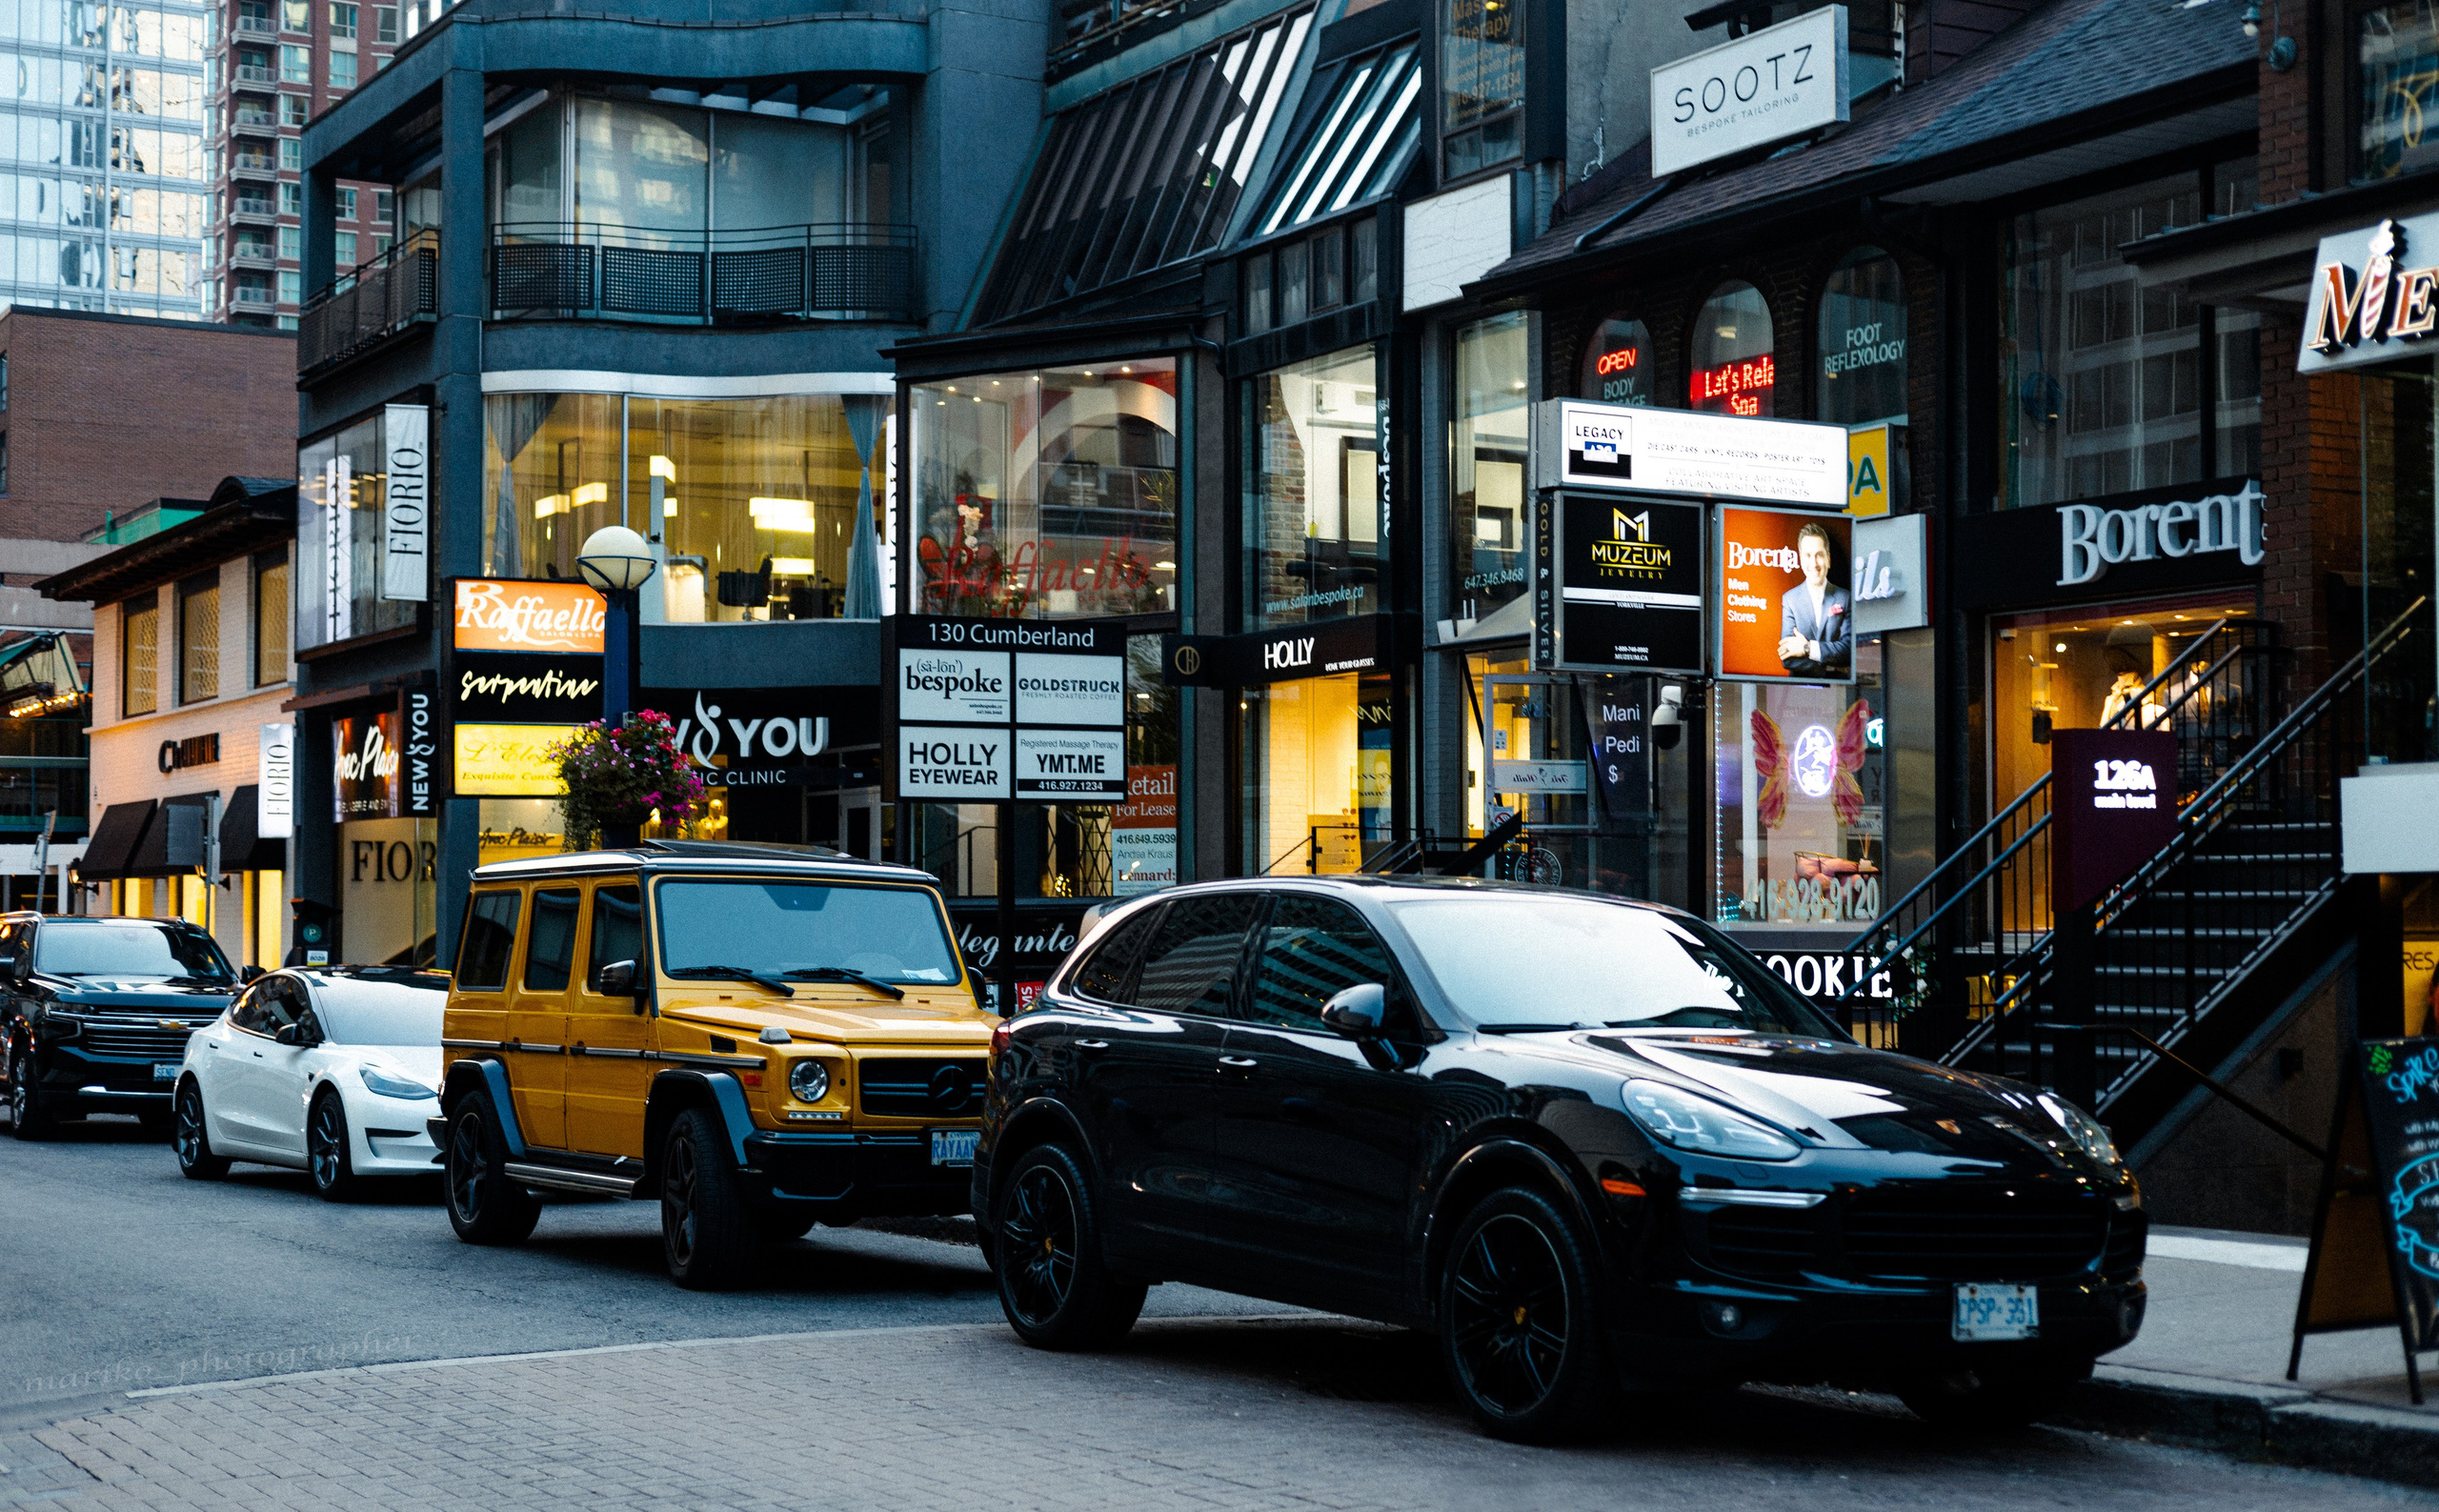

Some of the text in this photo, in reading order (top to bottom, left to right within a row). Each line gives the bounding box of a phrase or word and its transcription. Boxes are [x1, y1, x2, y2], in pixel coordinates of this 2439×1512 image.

[1453, 12, 1512, 48] Therapy
[1674, 44, 1813, 123] SOOTZ
[1687, 93, 1799, 137] BESPOKE TAILORING
[1846, 323, 1882, 346] FOOT
[1598, 348, 1637, 374] OPEN
[1824, 338, 1905, 375] REFLEXOLOGY
[1604, 377, 1635, 399] BODY
[1704, 364, 1739, 397] Let's
[1576, 425, 1623, 440] LEGACY
[1726, 449, 1759, 459] RECORDS
[390, 448, 424, 556] FIORIO
[1769, 486, 1810, 497] ARTISTS
[1540, 502, 1549, 556] GOLD
[2056, 478, 2268, 586] Borent
[1591, 543, 1671, 567] MUZEUM
[1464, 567, 1524, 590] 647.346.8468
[1600, 568, 1663, 580] JEWELRY
[1727, 577, 1749, 591] Men
[1265, 584, 1364, 615] www.salonbespoke.ca
[1727, 594, 1767, 610] Clothing
[456, 595, 606, 642] Raffaello
[1540, 590, 1549, 659] SILVER
[1727, 609, 1757, 623] Stores
[929, 623, 1095, 648] 130 Cumberland
[1264, 637, 1315, 670] HOLLY
[906, 666, 1002, 699] bespoke
[1018, 678, 1120, 694] GOLDSTRUCK
[1602, 704, 1640, 722] Mani
[727, 716, 829, 757] YOU
[1020, 738, 1119, 751] Registered Massage Therapy
[1605, 736, 1640, 754] Pedi
[412, 694, 429, 811] NEW YOU
[909, 742, 998, 766] HOLLY
[1037, 754, 1105, 774] YMT.ME
[267, 744, 290, 816] FIORIO
[726, 770, 786, 785] CLINIC
[909, 768, 998, 785] EYEWEAR
[1608, 764, 1619, 784] $
[1038, 780, 1103, 792] 416.927.1234
[1116, 802, 1176, 816] For Lease
[1117, 834, 1176, 845] 416.649.5939
[1118, 849, 1145, 859] Andrea
[1744, 877, 1880, 920] 416-928-9120
[1755, 954, 1893, 998] OOKIE
